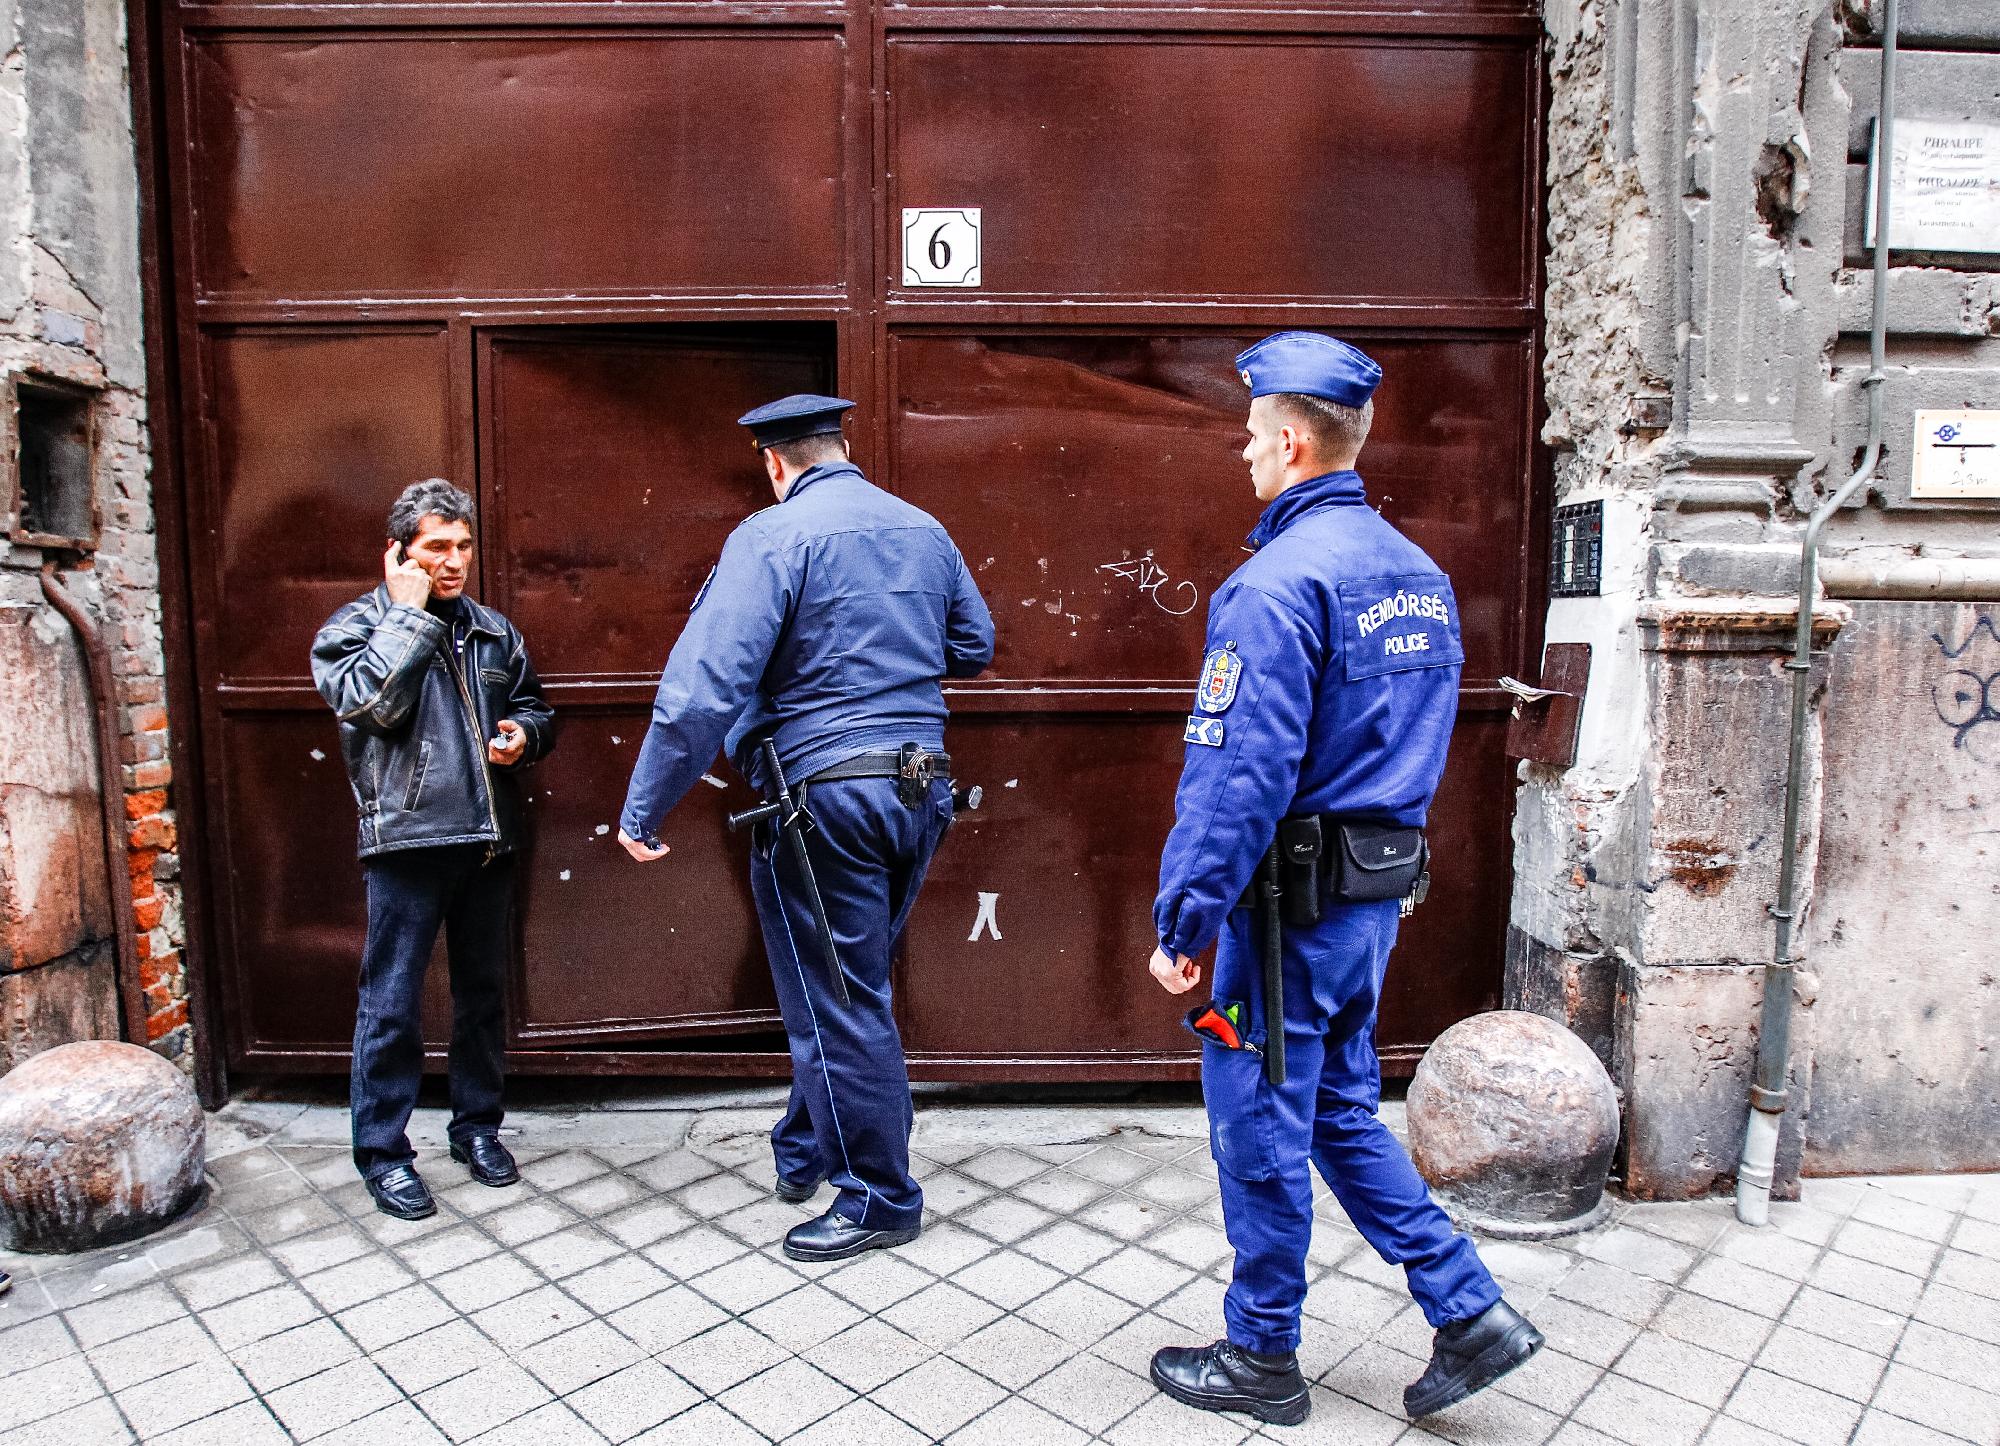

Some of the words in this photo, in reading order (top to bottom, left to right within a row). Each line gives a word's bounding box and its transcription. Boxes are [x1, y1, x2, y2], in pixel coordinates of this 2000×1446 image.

[1923, 136, 1983, 149] PHRALIPE
[928, 222, 951, 270] 6
[1357, 589, 1449, 638] RENDŐRSÉG
[1384, 632, 1430, 656] POLICE
